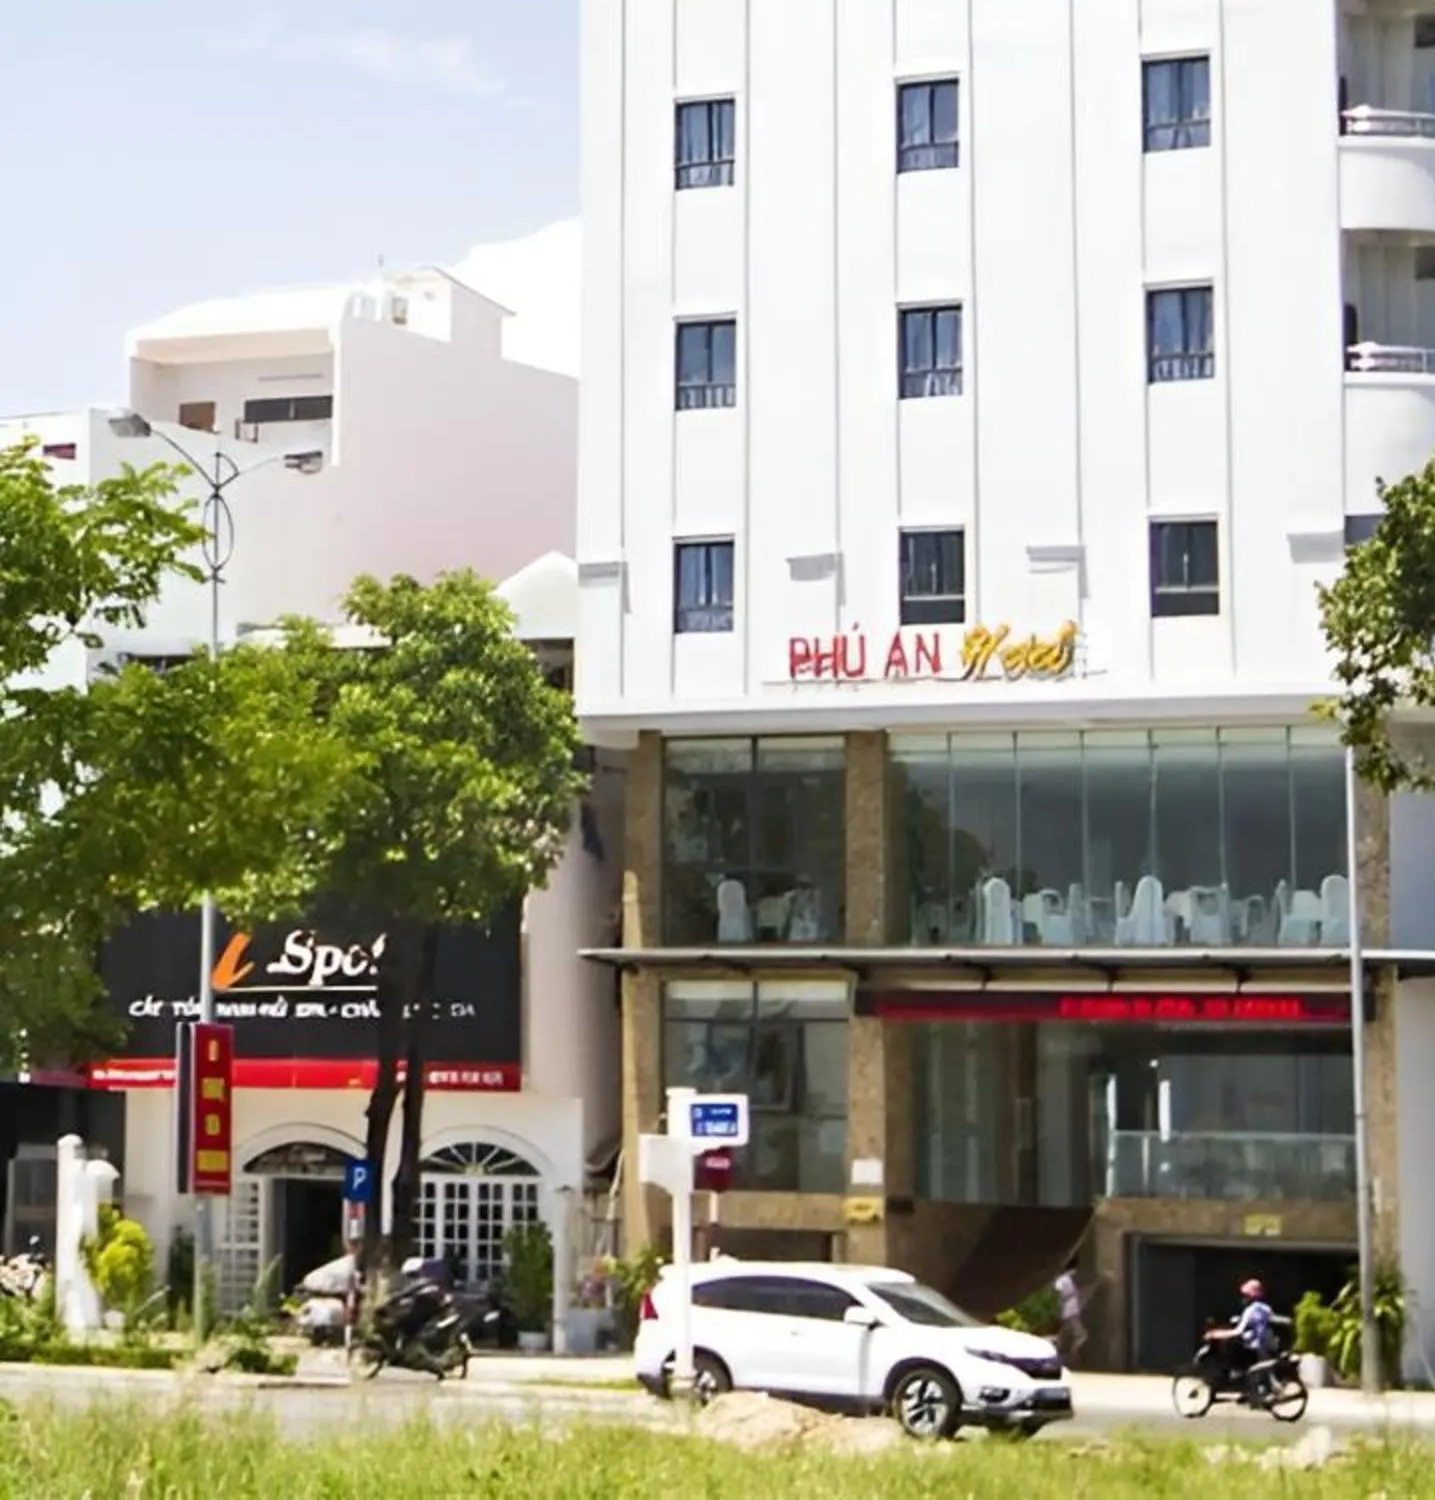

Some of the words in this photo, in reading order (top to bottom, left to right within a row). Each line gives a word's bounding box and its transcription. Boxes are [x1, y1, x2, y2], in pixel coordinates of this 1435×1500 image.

[789, 621, 866, 678] PHÚ
[884, 631, 942, 679] AN
[352, 1167, 367, 1190] P
